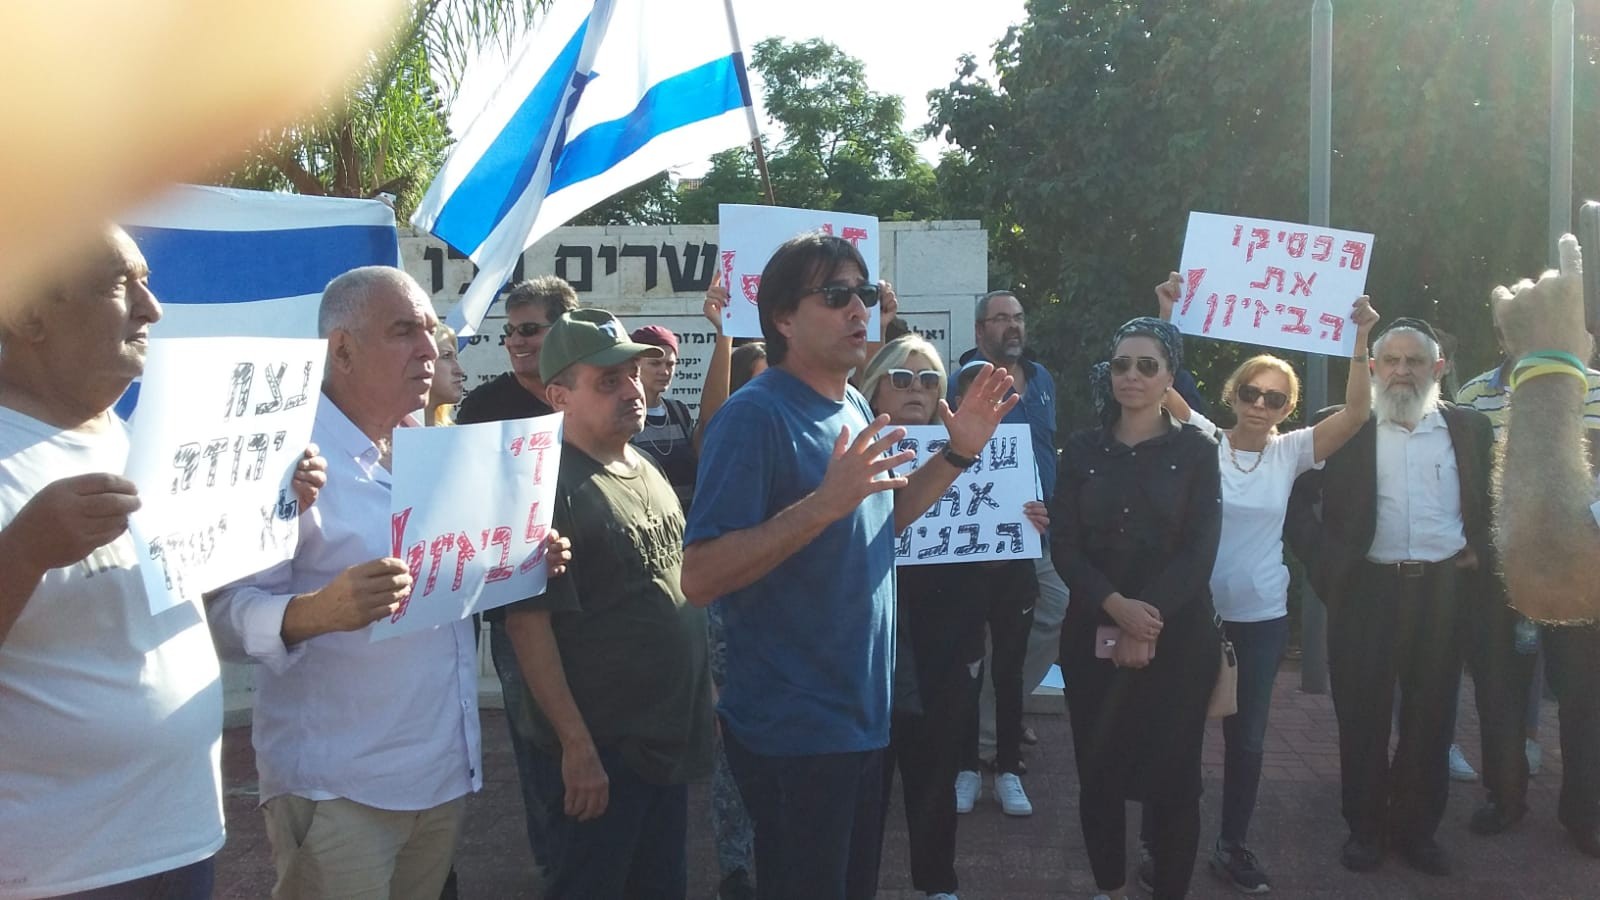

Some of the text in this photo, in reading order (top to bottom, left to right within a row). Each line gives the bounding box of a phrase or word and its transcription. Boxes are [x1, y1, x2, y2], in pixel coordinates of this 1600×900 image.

[1231, 224, 1367, 271] הפסיקו
[1250, 266, 1318, 297] את
[225, 360, 313, 422] נצח
[171, 429, 287, 495] יהודה
[510, 431, 554, 486] די
[926, 482, 1001, 517] את
